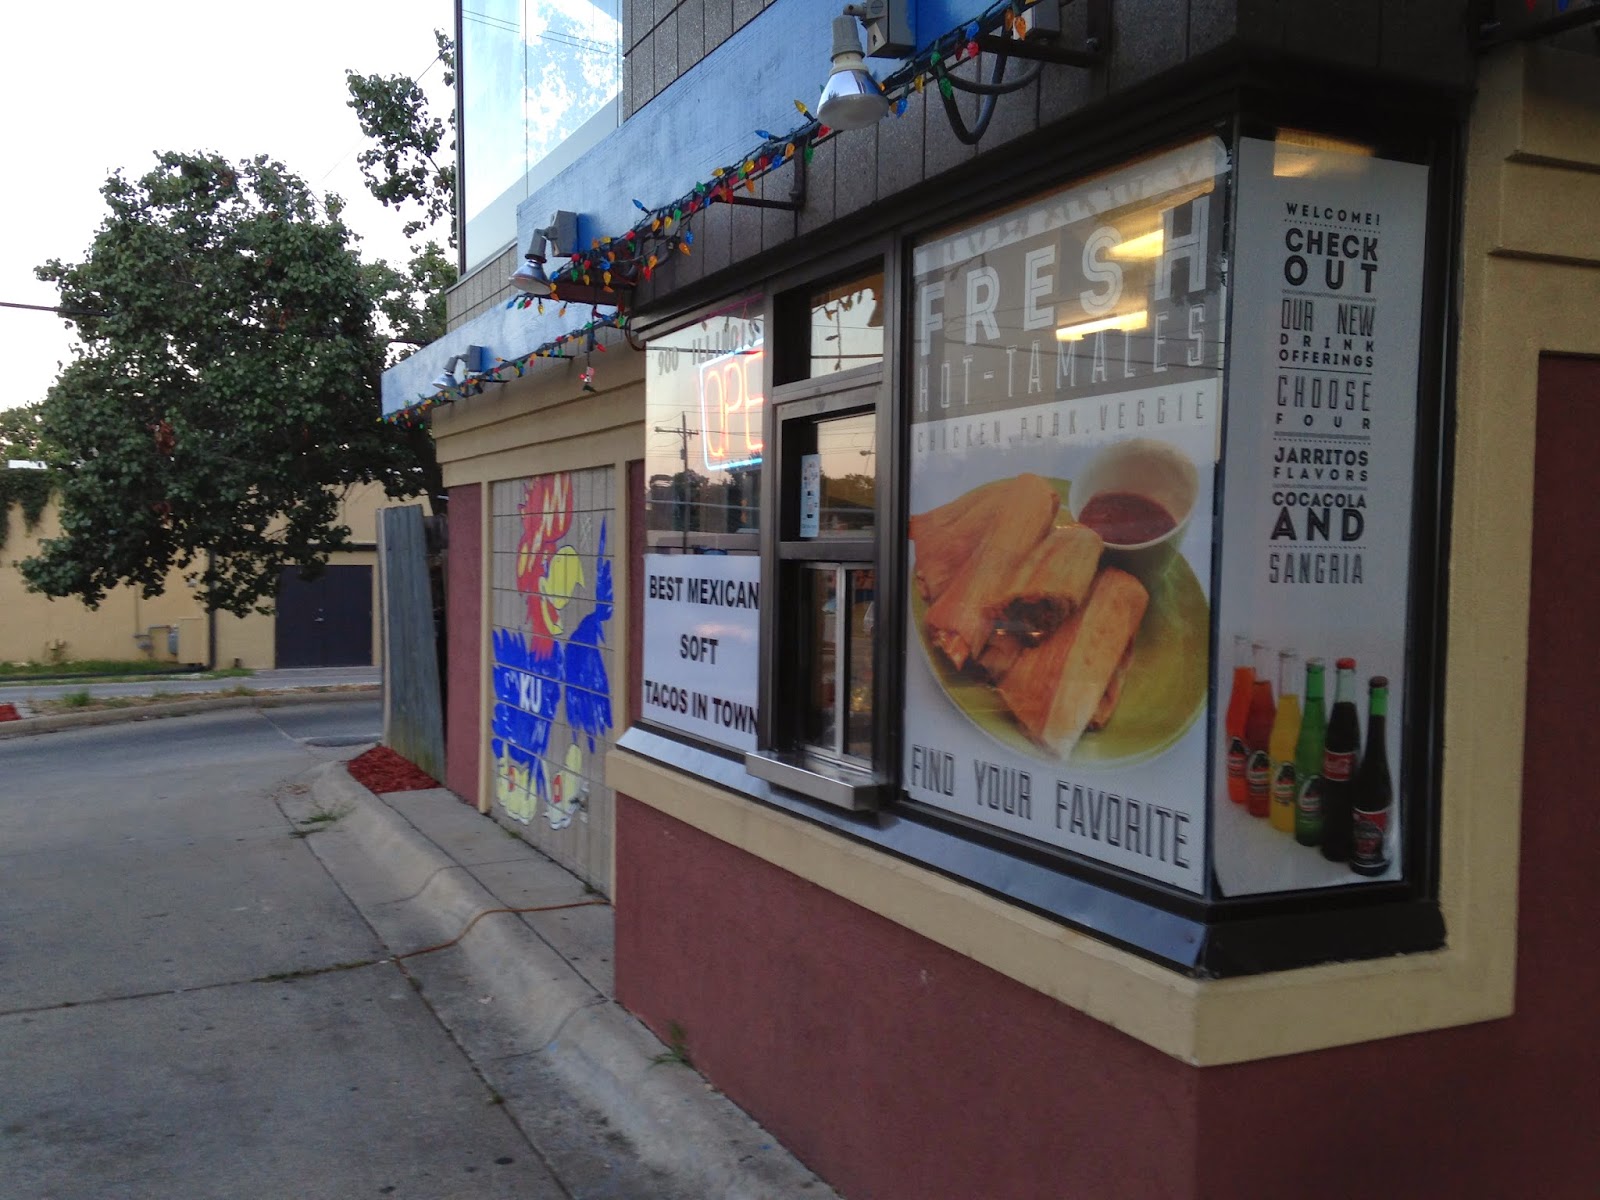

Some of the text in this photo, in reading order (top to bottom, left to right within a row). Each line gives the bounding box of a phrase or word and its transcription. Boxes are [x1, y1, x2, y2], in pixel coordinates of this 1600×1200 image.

[1286, 203, 1380, 225] WELCOME!
[1285, 227, 1379, 262] CHECK
[919, 195, 1210, 356] FRESH
[1284, 254, 1378, 293] OUT
[1281, 298, 1375, 336] OUR NEW
[1279, 348, 1374, 368] OFFERINGS
[1280, 332, 1374, 352] DRINK
[657, 345, 680, 376] 900
[1276, 374, 1372, 412] CHOOSE
[1099, 391, 1205, 431] VEGGIE
[1276, 412, 1370, 430] FOUR
[1273, 466, 1368, 482] FLAVORS
[1274, 446, 1369, 467] JARRITOS
[1272, 491, 1367, 509] COCACOLA
[1270, 506, 1365, 542] AND
[1269, 552, 1363, 584] SANGRIA
[650, 574, 760, 610] BEST MEXICAN
[680, 633, 719, 665] SOFT
[519, 671, 543, 714] KU
[645, 680, 759, 735] TACOS IN TOWN
[912, 744, 1190, 869] FIND YOUR FAVORITE
